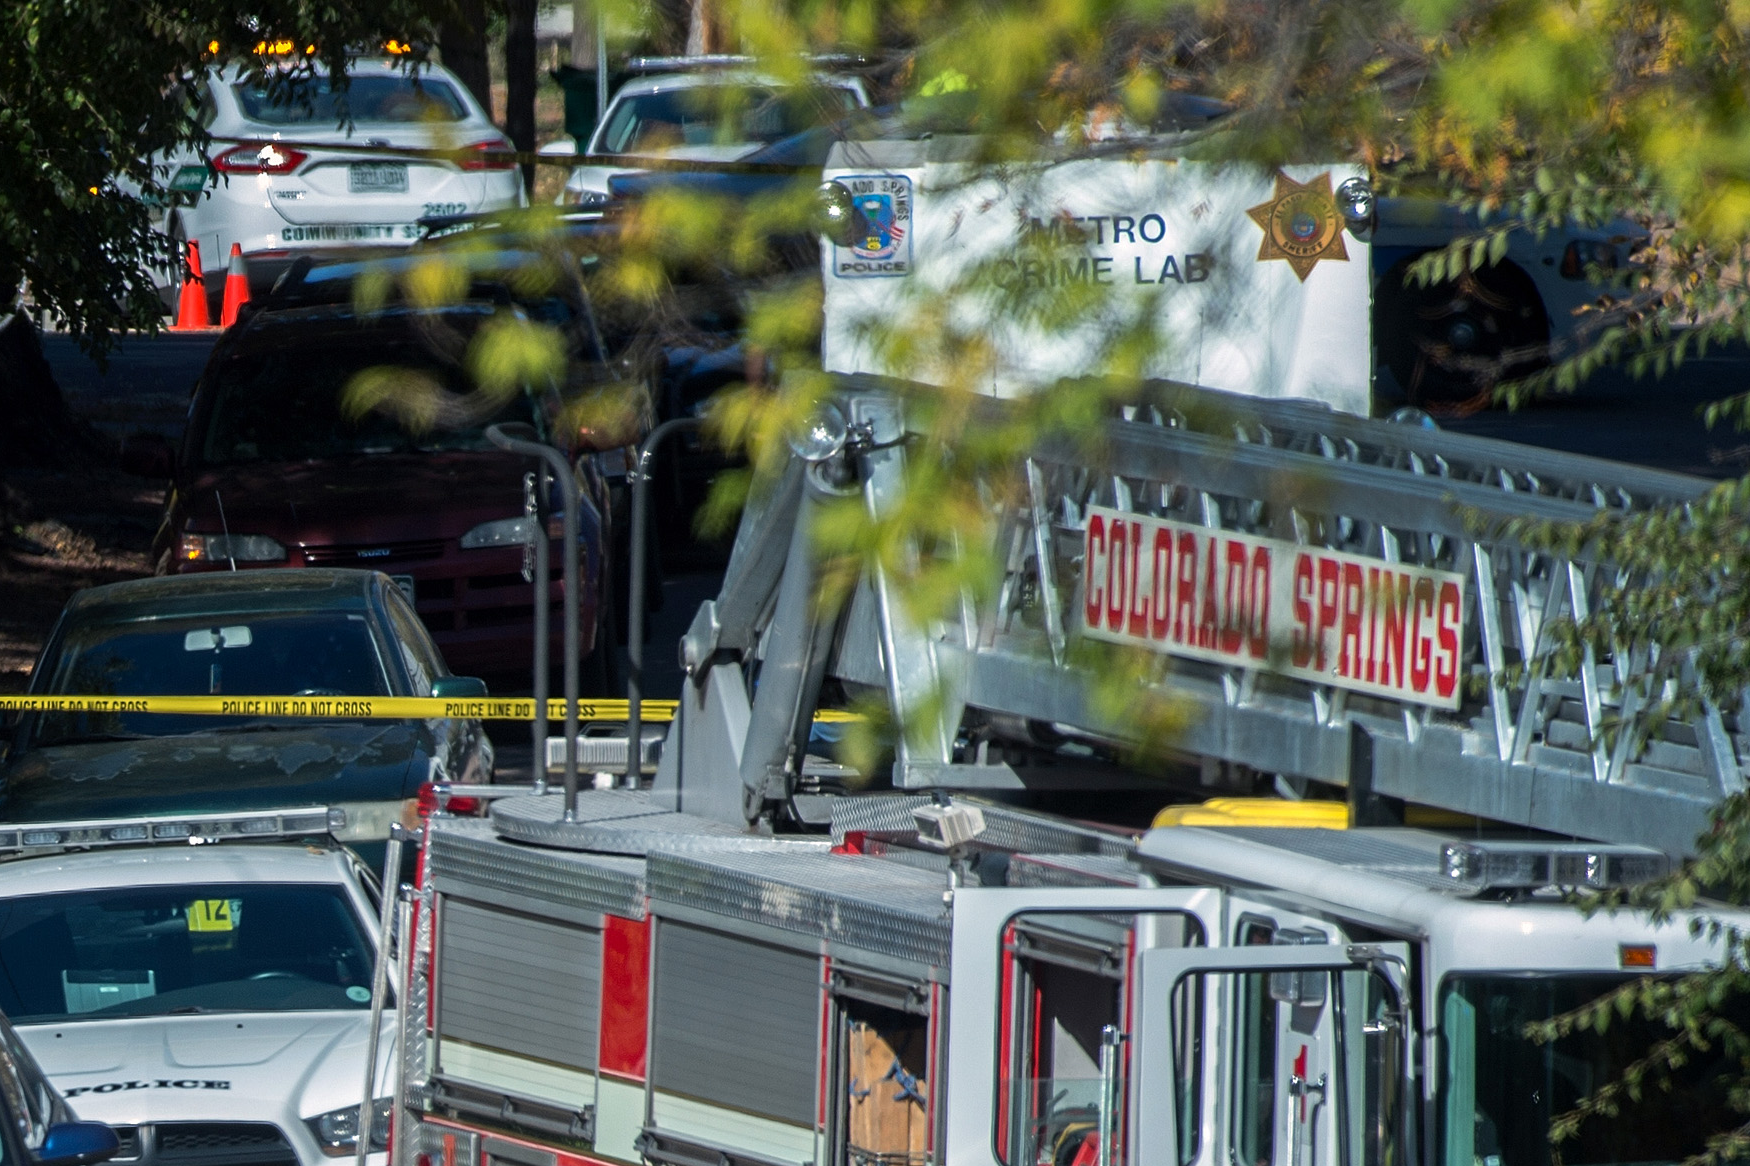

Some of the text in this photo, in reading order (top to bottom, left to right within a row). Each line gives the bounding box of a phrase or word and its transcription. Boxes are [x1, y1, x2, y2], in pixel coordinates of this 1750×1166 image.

[841, 261, 906, 273] POLICE
[1135, 253, 1210, 285] LAB
[1085, 513, 1461, 699] COLORADO SPRINGS
[0, 700, 148, 712] POLICE LINE DO NOT CROSS
[222, 701, 372, 716] POLICE LINE DO NOT CROSS
[445, 703, 483, 716] POLICE
[488, 703, 512, 716] LINE
[515, 704, 530, 717] DO
[64, 1079, 231, 1098] POLICE
